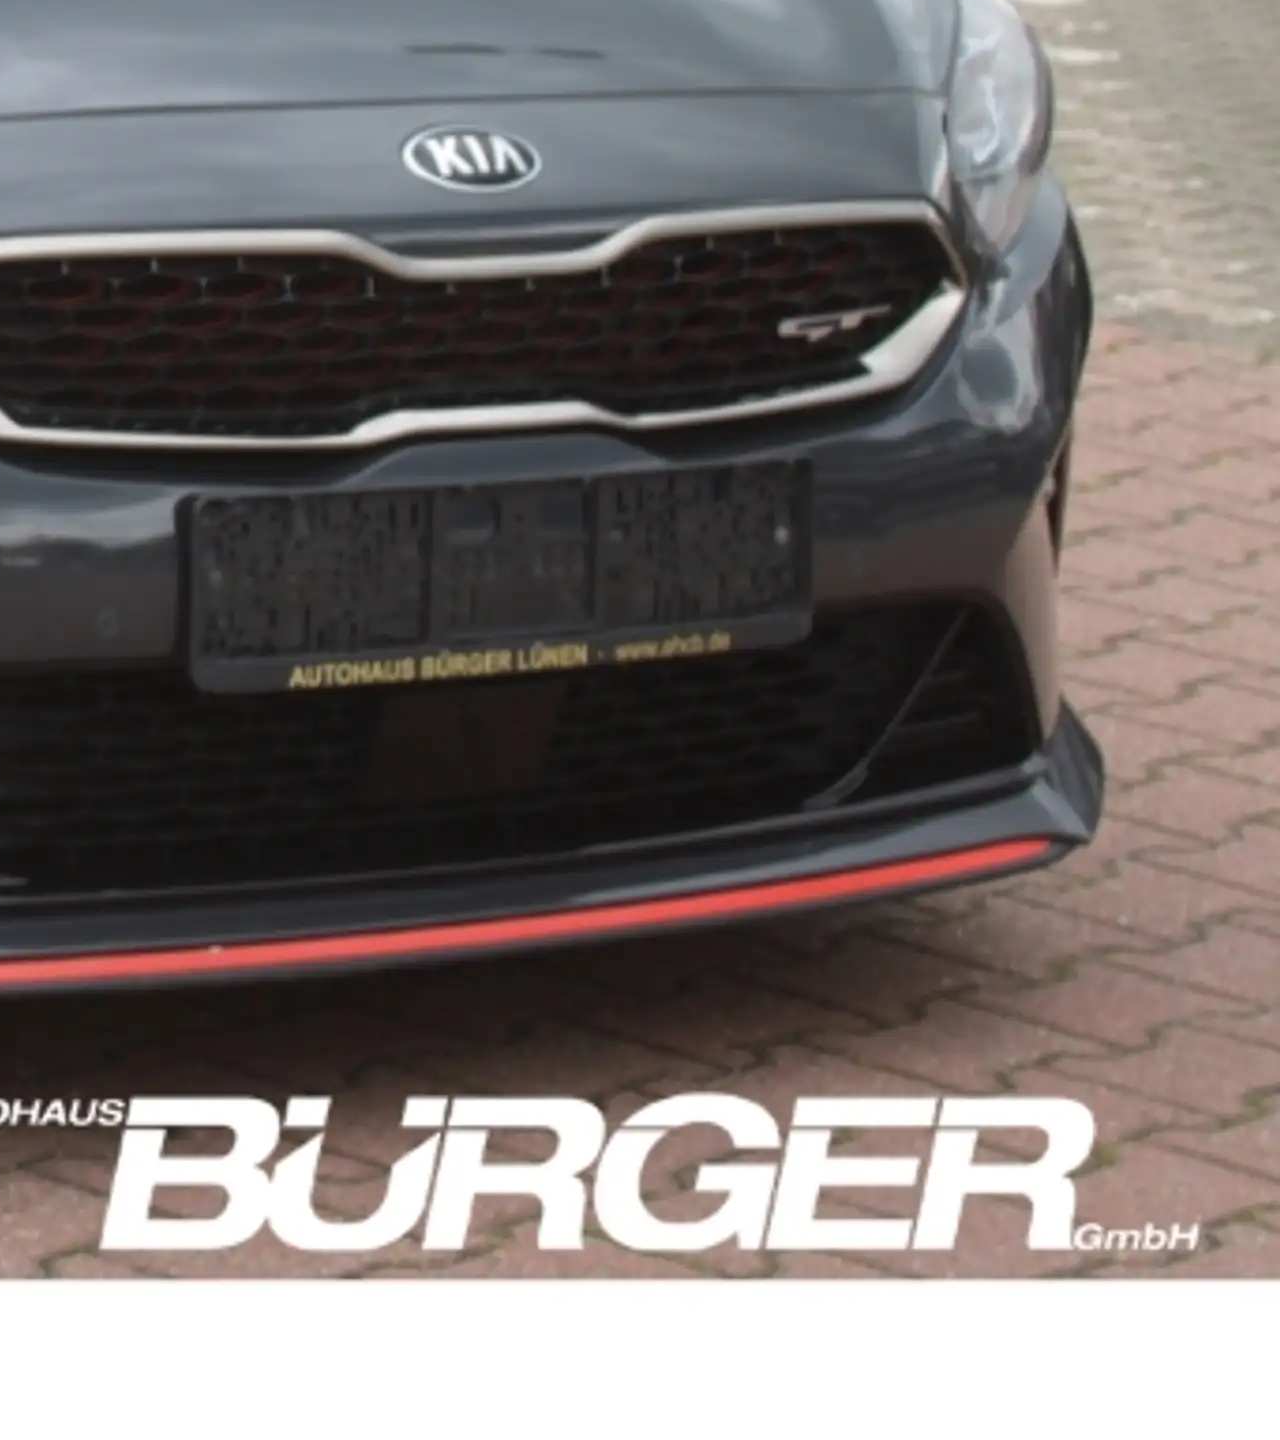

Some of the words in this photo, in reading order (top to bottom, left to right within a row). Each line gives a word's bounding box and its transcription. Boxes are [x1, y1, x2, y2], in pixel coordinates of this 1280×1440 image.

[425, 134, 526, 176] KIA
[290, 655, 415, 690] AUTOHAUS
[420, 648, 511, 681] BÜRGER
[517, 640, 588, 671] LÜNEN
